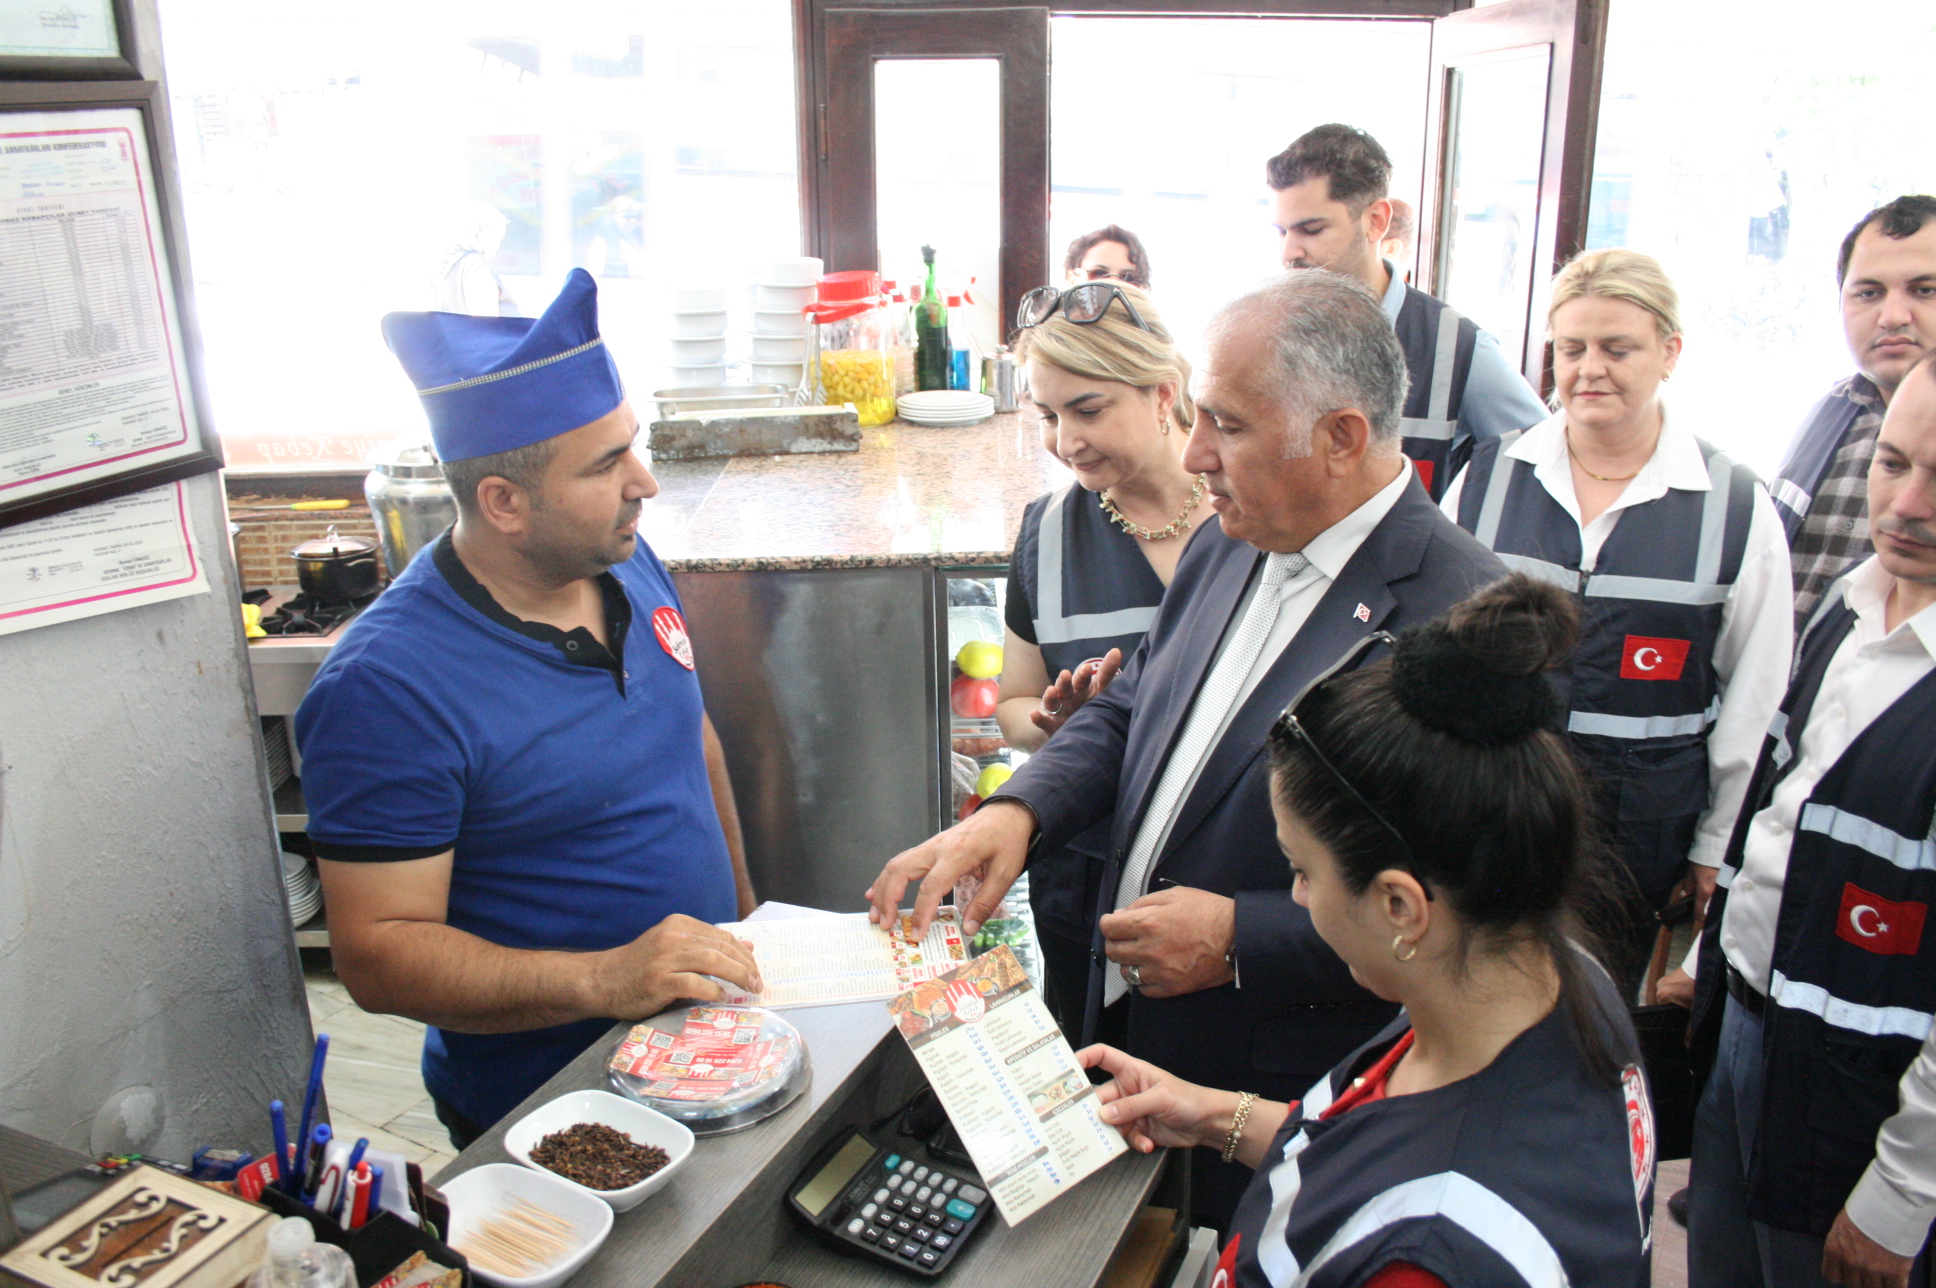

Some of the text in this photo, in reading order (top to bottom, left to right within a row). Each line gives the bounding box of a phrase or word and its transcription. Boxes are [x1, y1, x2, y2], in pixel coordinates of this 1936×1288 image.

[989, 988, 1020, 1008] LAHMACUNLAR
[984, 1017, 1000, 1027] Lahmacun
[995, 1019, 1011, 1029] Lahmacun
[1005, 1030, 1021, 1040] Lahmacun
[1010, 1035, 1026, 1046] Lahmacun
[1031, 1033, 1055, 1049] SALATALAR
[258, 1162, 274, 1184] 0284
[894, 1199, 903, 1207] 9
[881, 1213, 891, 1221] 8
[930, 1214, 940, 1222] 3
[900, 1221, 910, 1229] 5
[867, 1229, 878, 1237] 7
[918, 1229, 928, 1237] 2
[887, 1237, 897, 1245] 4
[936, 1236, 947, 1246] 00
[905, 1244, 915, 1252] 1
[924, 1253, 934, 1261] 0
